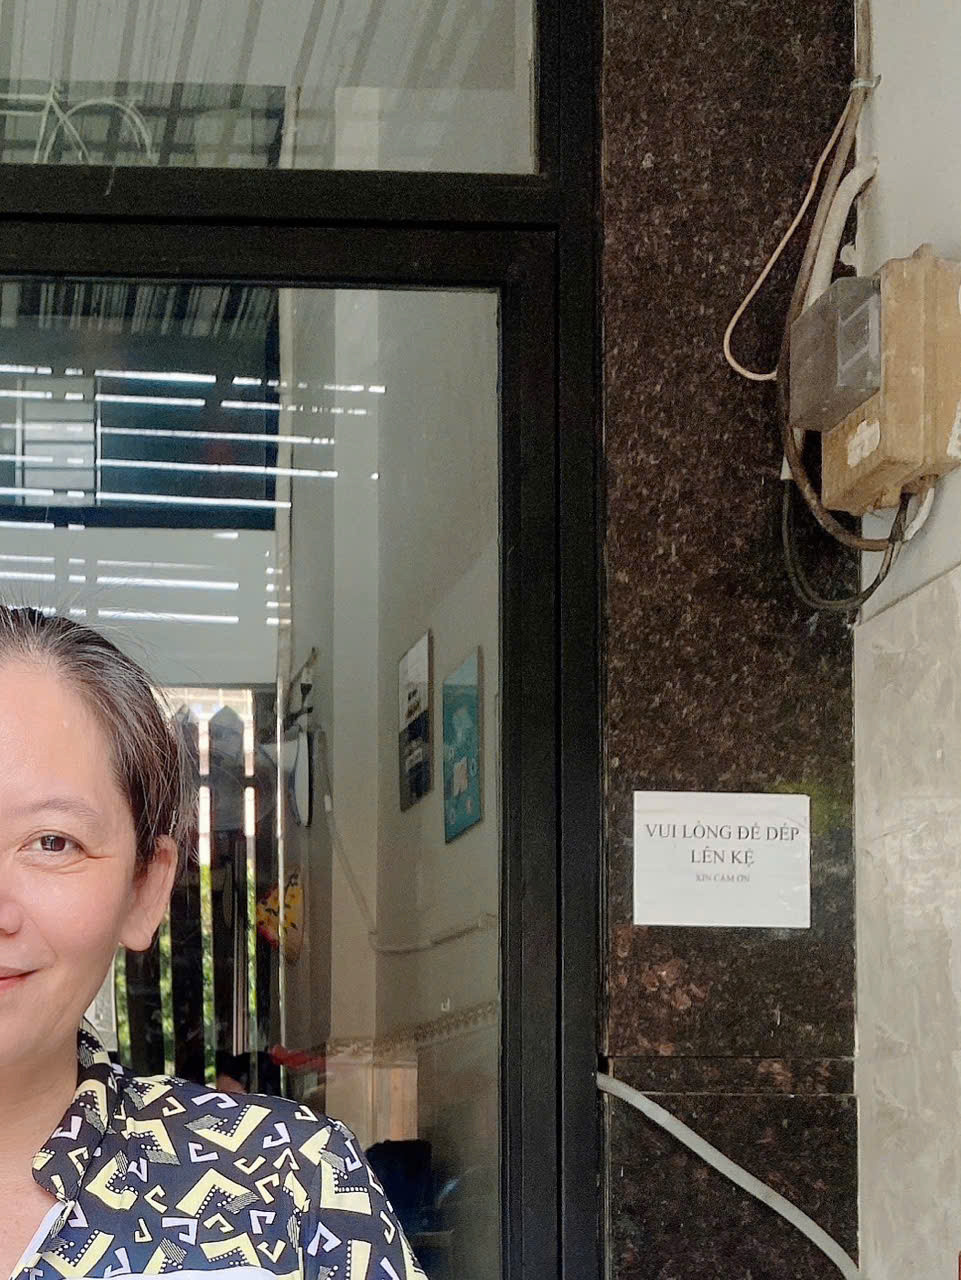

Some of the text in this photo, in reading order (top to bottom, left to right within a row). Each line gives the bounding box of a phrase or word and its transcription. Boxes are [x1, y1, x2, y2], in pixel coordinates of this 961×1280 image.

[645, 823, 677, 839] VUI
[690, 846, 725, 865] LÊN
[695, 872, 712, 883] XIN
